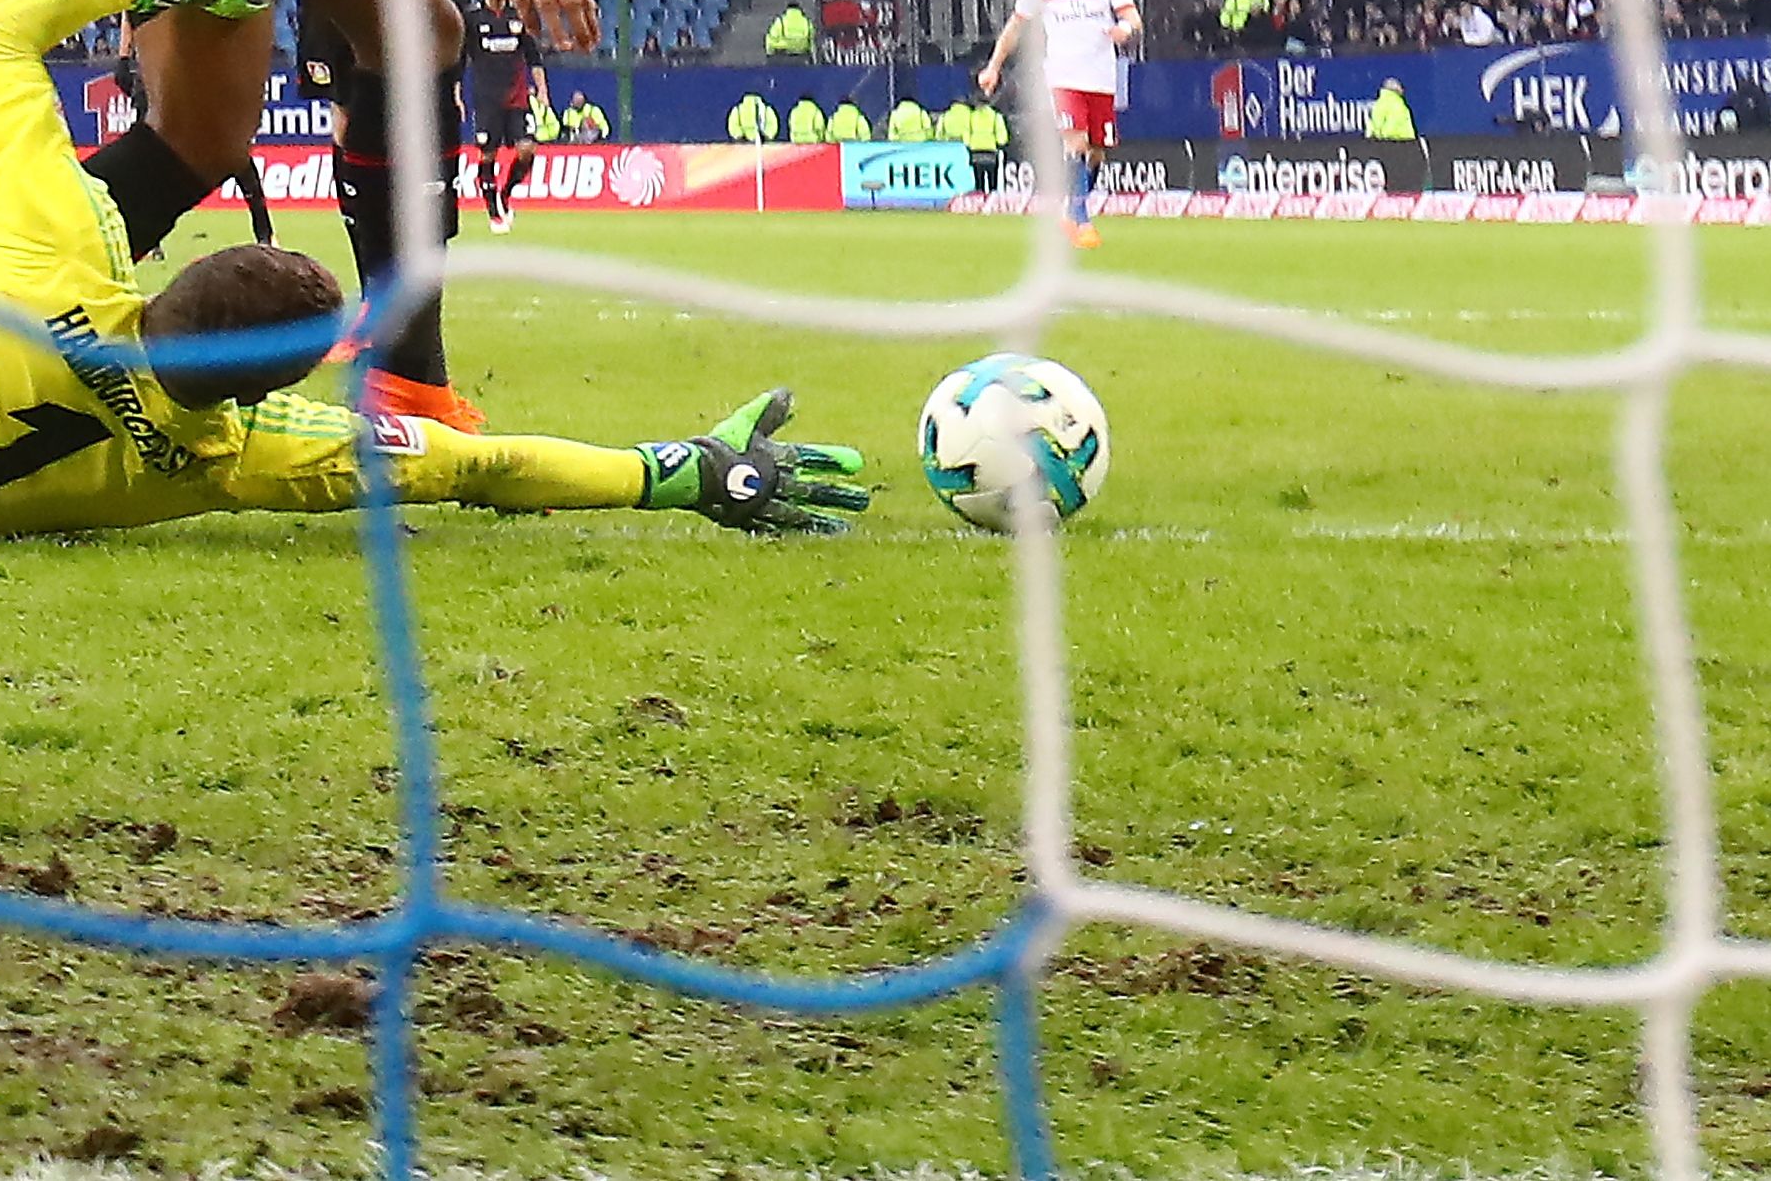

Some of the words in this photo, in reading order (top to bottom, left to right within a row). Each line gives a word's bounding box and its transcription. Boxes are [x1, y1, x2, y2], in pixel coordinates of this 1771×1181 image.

[1513, 74, 1592, 132] HEK
[510, 155, 606, 199] LUB
[888, 162, 955, 190] HEK
[1218, 146, 1387, 196] enterprise
[44, 304, 171, 469] HABURGER
